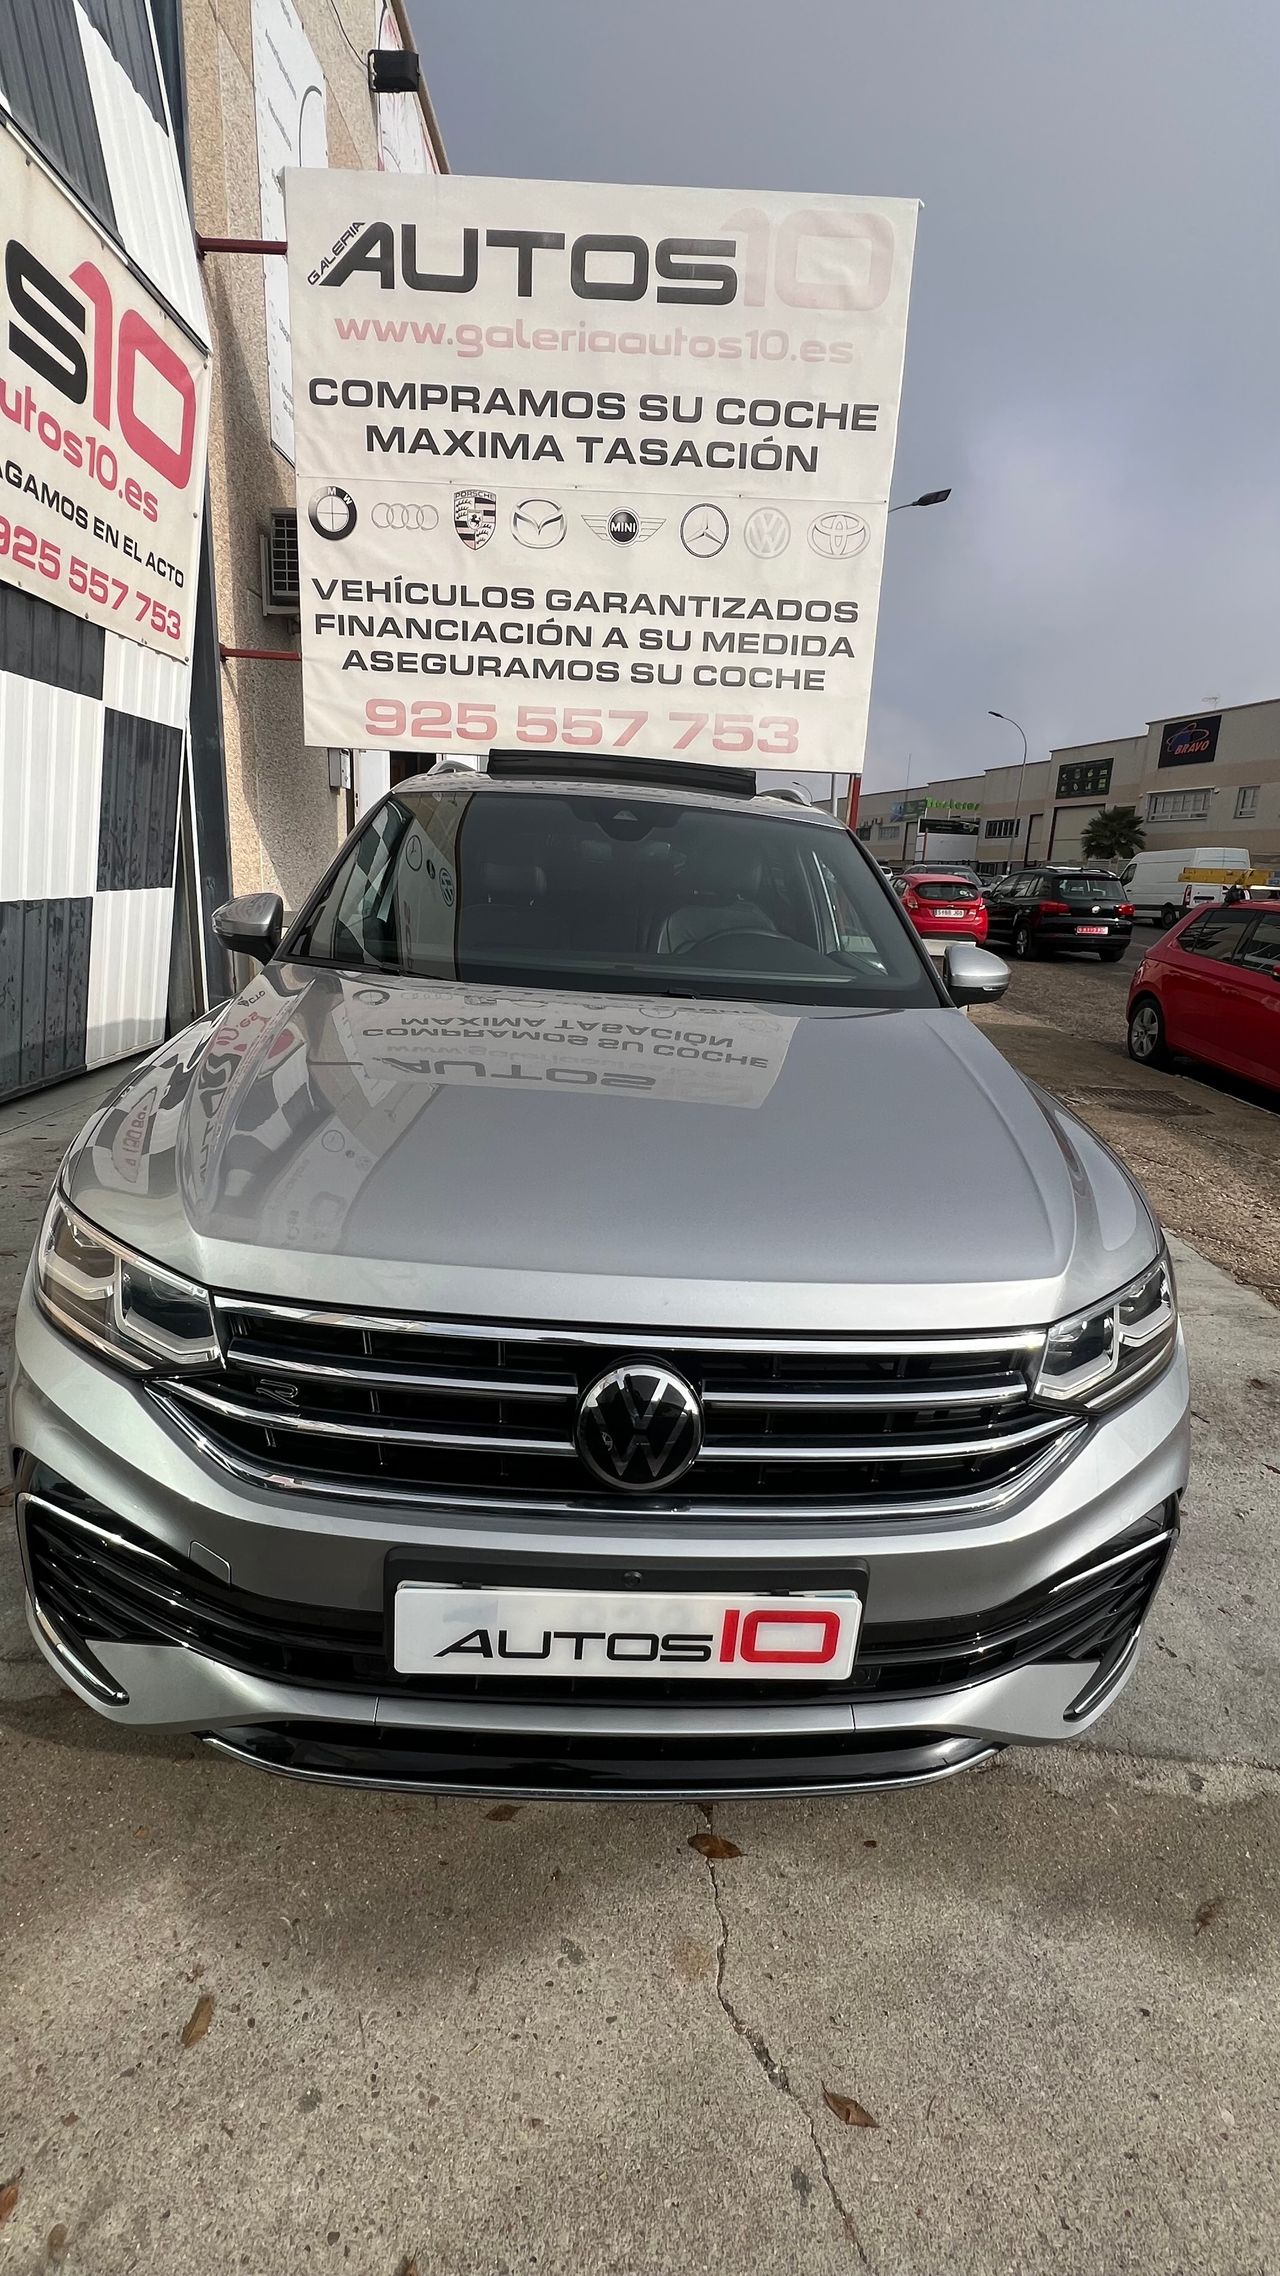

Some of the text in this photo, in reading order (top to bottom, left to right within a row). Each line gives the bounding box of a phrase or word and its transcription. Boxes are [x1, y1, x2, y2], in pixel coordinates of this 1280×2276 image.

[307, 221, 366, 286] GALERIA
[334, 317, 854, 365] www.galeriaautos10.es
[308, 377, 626, 420] COMPRAMOS
[639, 393, 702, 424] SU
[716, 397, 880, 432] COCHE
[365, 424, 819, 473] MAXIMA TASACIÓN
[0, 460, 184, 588] GAMOS EN EL ACTO
[611, 521, 636, 533] MINI
[69, 555, 129, 610] 557
[135, 590, 181, 640] 753
[311, 574, 859, 623] VEHÍCULOS GARANTIZADOS
[314, 615, 855, 658] FINANCIACIÓN A SU MEDIDA
[342, 649, 826, 691] ASEGURAMOS SU COCHE
[365, 698, 799, 754] 925 557 753
[1174, 740, 1210, 755] BRAVO
[433, 1609, 841, 1664] AUTOS10
